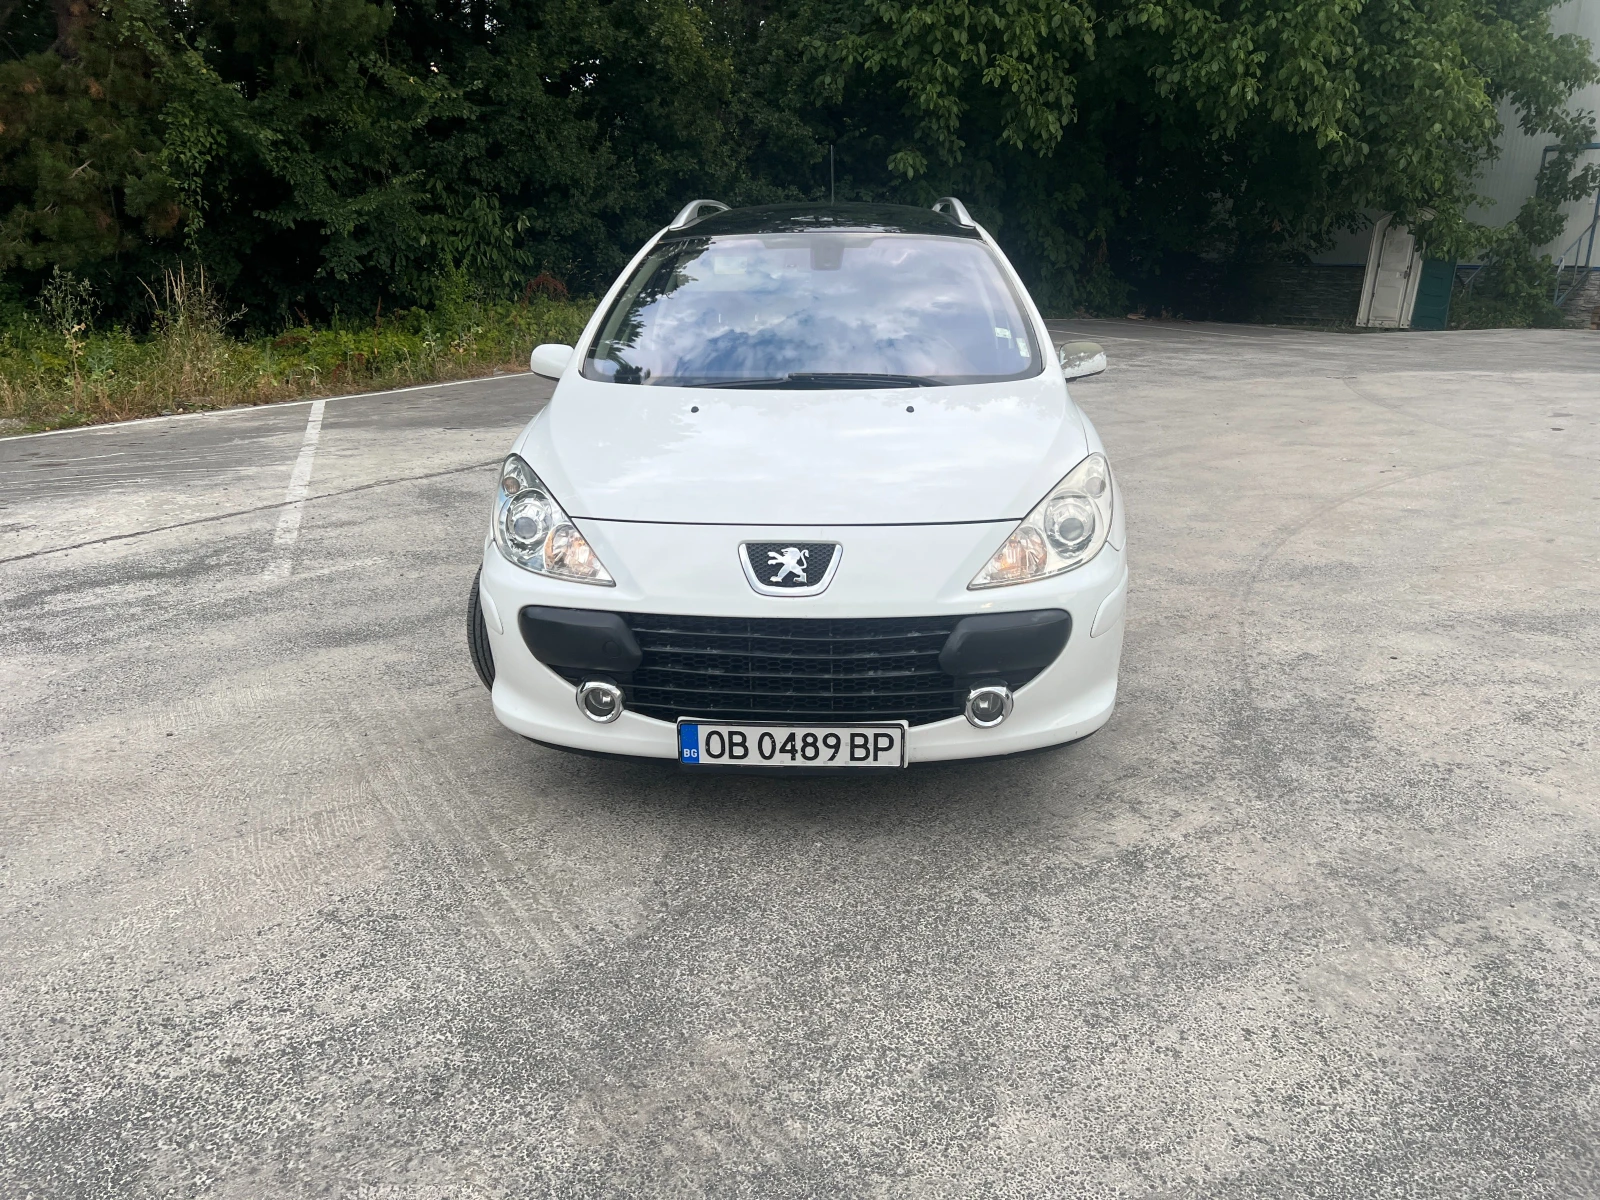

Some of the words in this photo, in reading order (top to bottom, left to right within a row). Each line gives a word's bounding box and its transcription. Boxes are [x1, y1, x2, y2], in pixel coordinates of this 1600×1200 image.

[683, 748, 698, 758] BG
[705, 730, 749, 760] OB
[758, 732, 841, 761] 0489
[850, 732, 894, 761] BP
